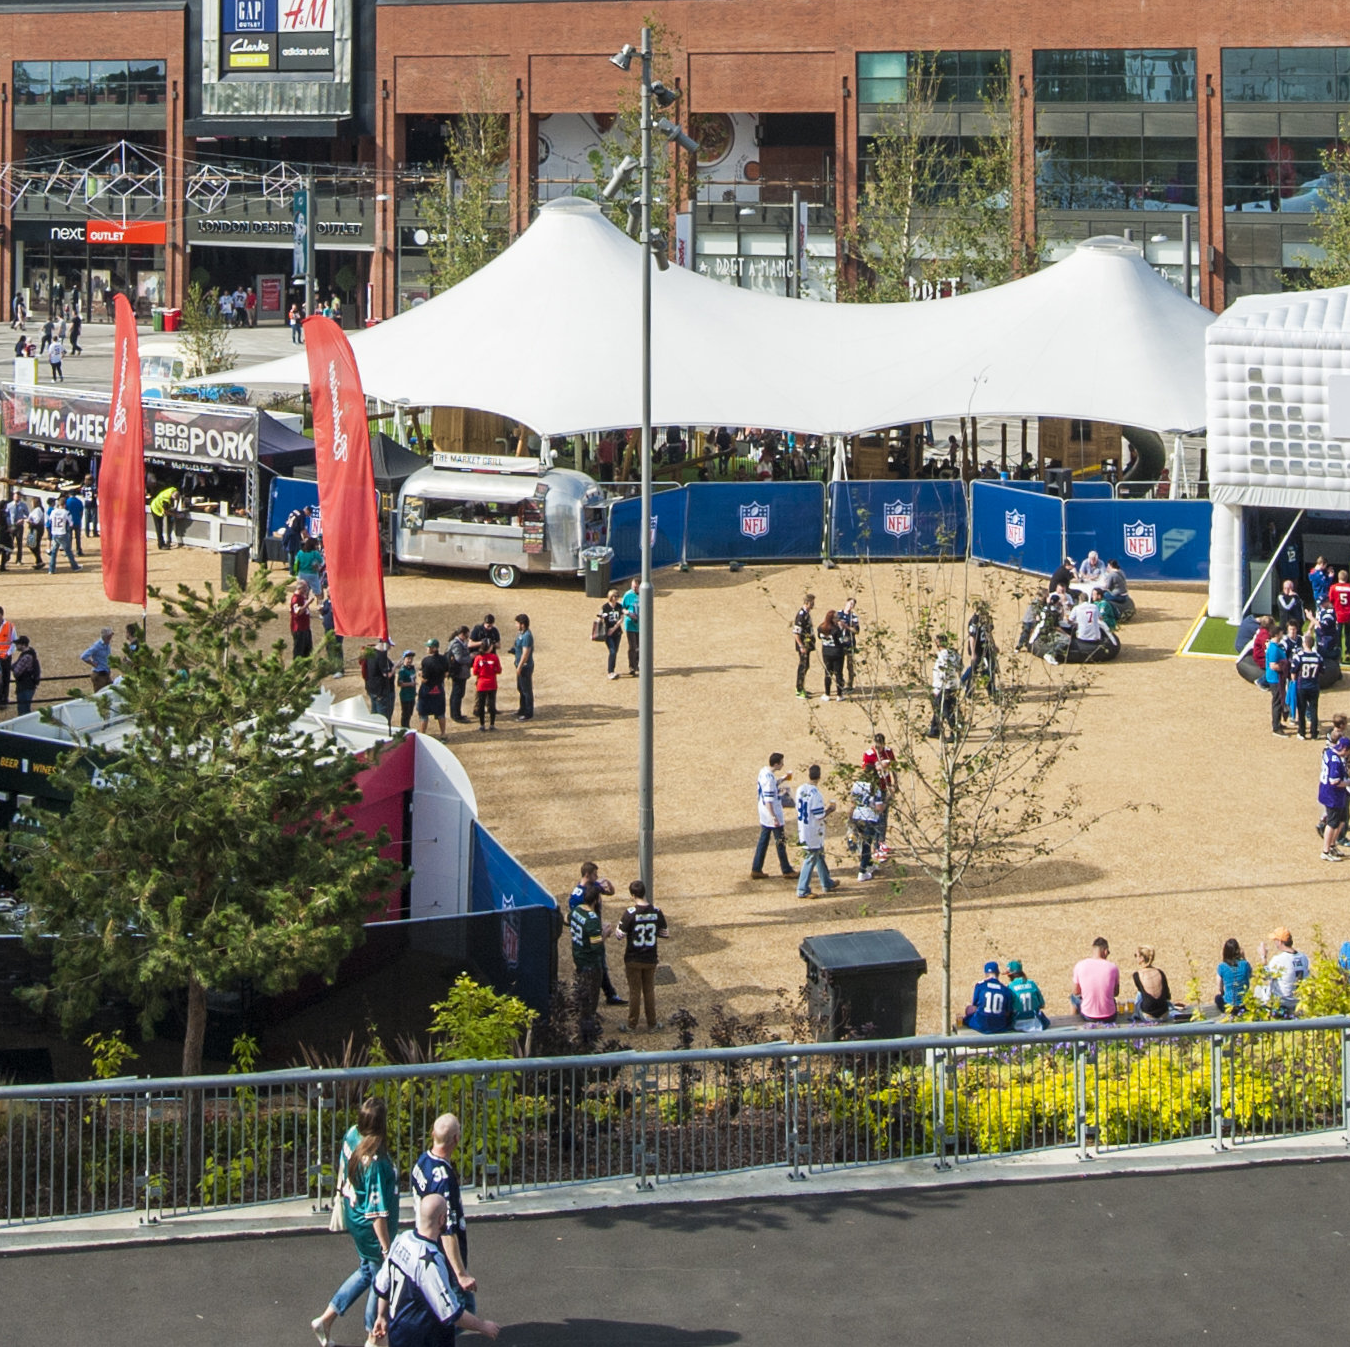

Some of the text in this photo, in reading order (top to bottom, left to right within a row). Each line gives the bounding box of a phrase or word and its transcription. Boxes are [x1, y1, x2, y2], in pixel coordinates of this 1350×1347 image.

[238, 0, 262, 21] GAP
[230, 38, 270, 53] Clarks
[282, 47, 330, 56] adidas outlet
[51, 227, 125, 241] next OUTLET
[198, 220, 363, 236] LONDON DESIGN OUTLET
[716, 257, 744, 277] PRET
[760, 258, 794, 279] MANG
[28, 408, 61, 439] MAC
[65, 411, 109, 444] CHEE
[154, 422, 254, 462] BBQ PORK
[154, 436, 189, 453] PULLED
[435, 453, 504, 467] THE MARKET GRILL
[53, 516, 64, 528] 12
[743, 517, 766, 534] NFL
[888, 516, 910, 533] NFL
[1008, 525, 1023, 543] NFL
[1128, 537, 1152, 555] NFL
[1339, 593, 1348, 605] 5
[1085, 610, 1094, 624] 7
[1301, 663, 1318, 678] 87
[0, 756, 57, 775] BEER WINES
[633, 923, 657, 947] 33
[984, 992, 1004, 1014] 10
[1018, 993, 1032, 1012] 11
[432, 1165, 449, 1182] 31
